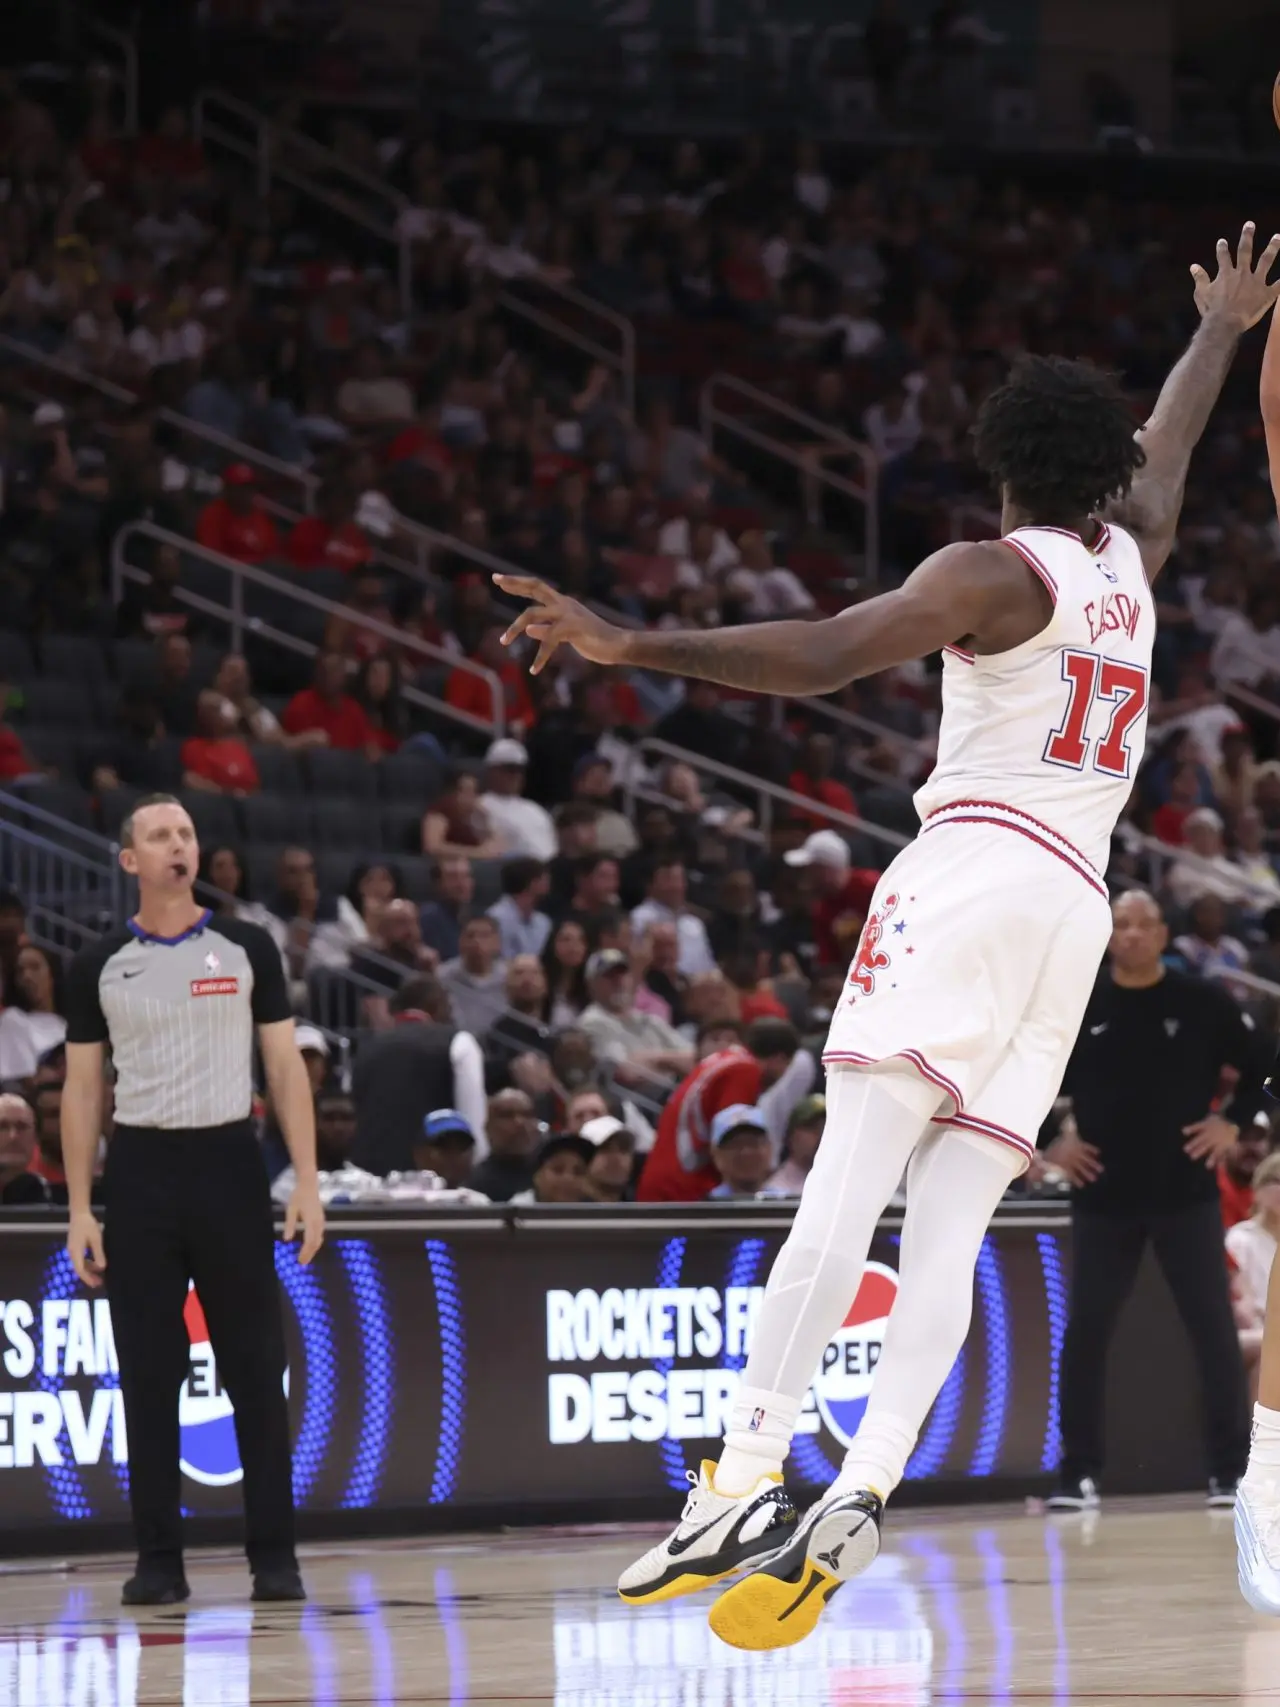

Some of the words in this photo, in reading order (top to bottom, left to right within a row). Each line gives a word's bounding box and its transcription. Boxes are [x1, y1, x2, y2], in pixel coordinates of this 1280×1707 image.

[1084, 592, 1141, 644] EASON
[1041, 648, 1148, 779] 17
[547, 1287, 723, 1361] ROCKETS
